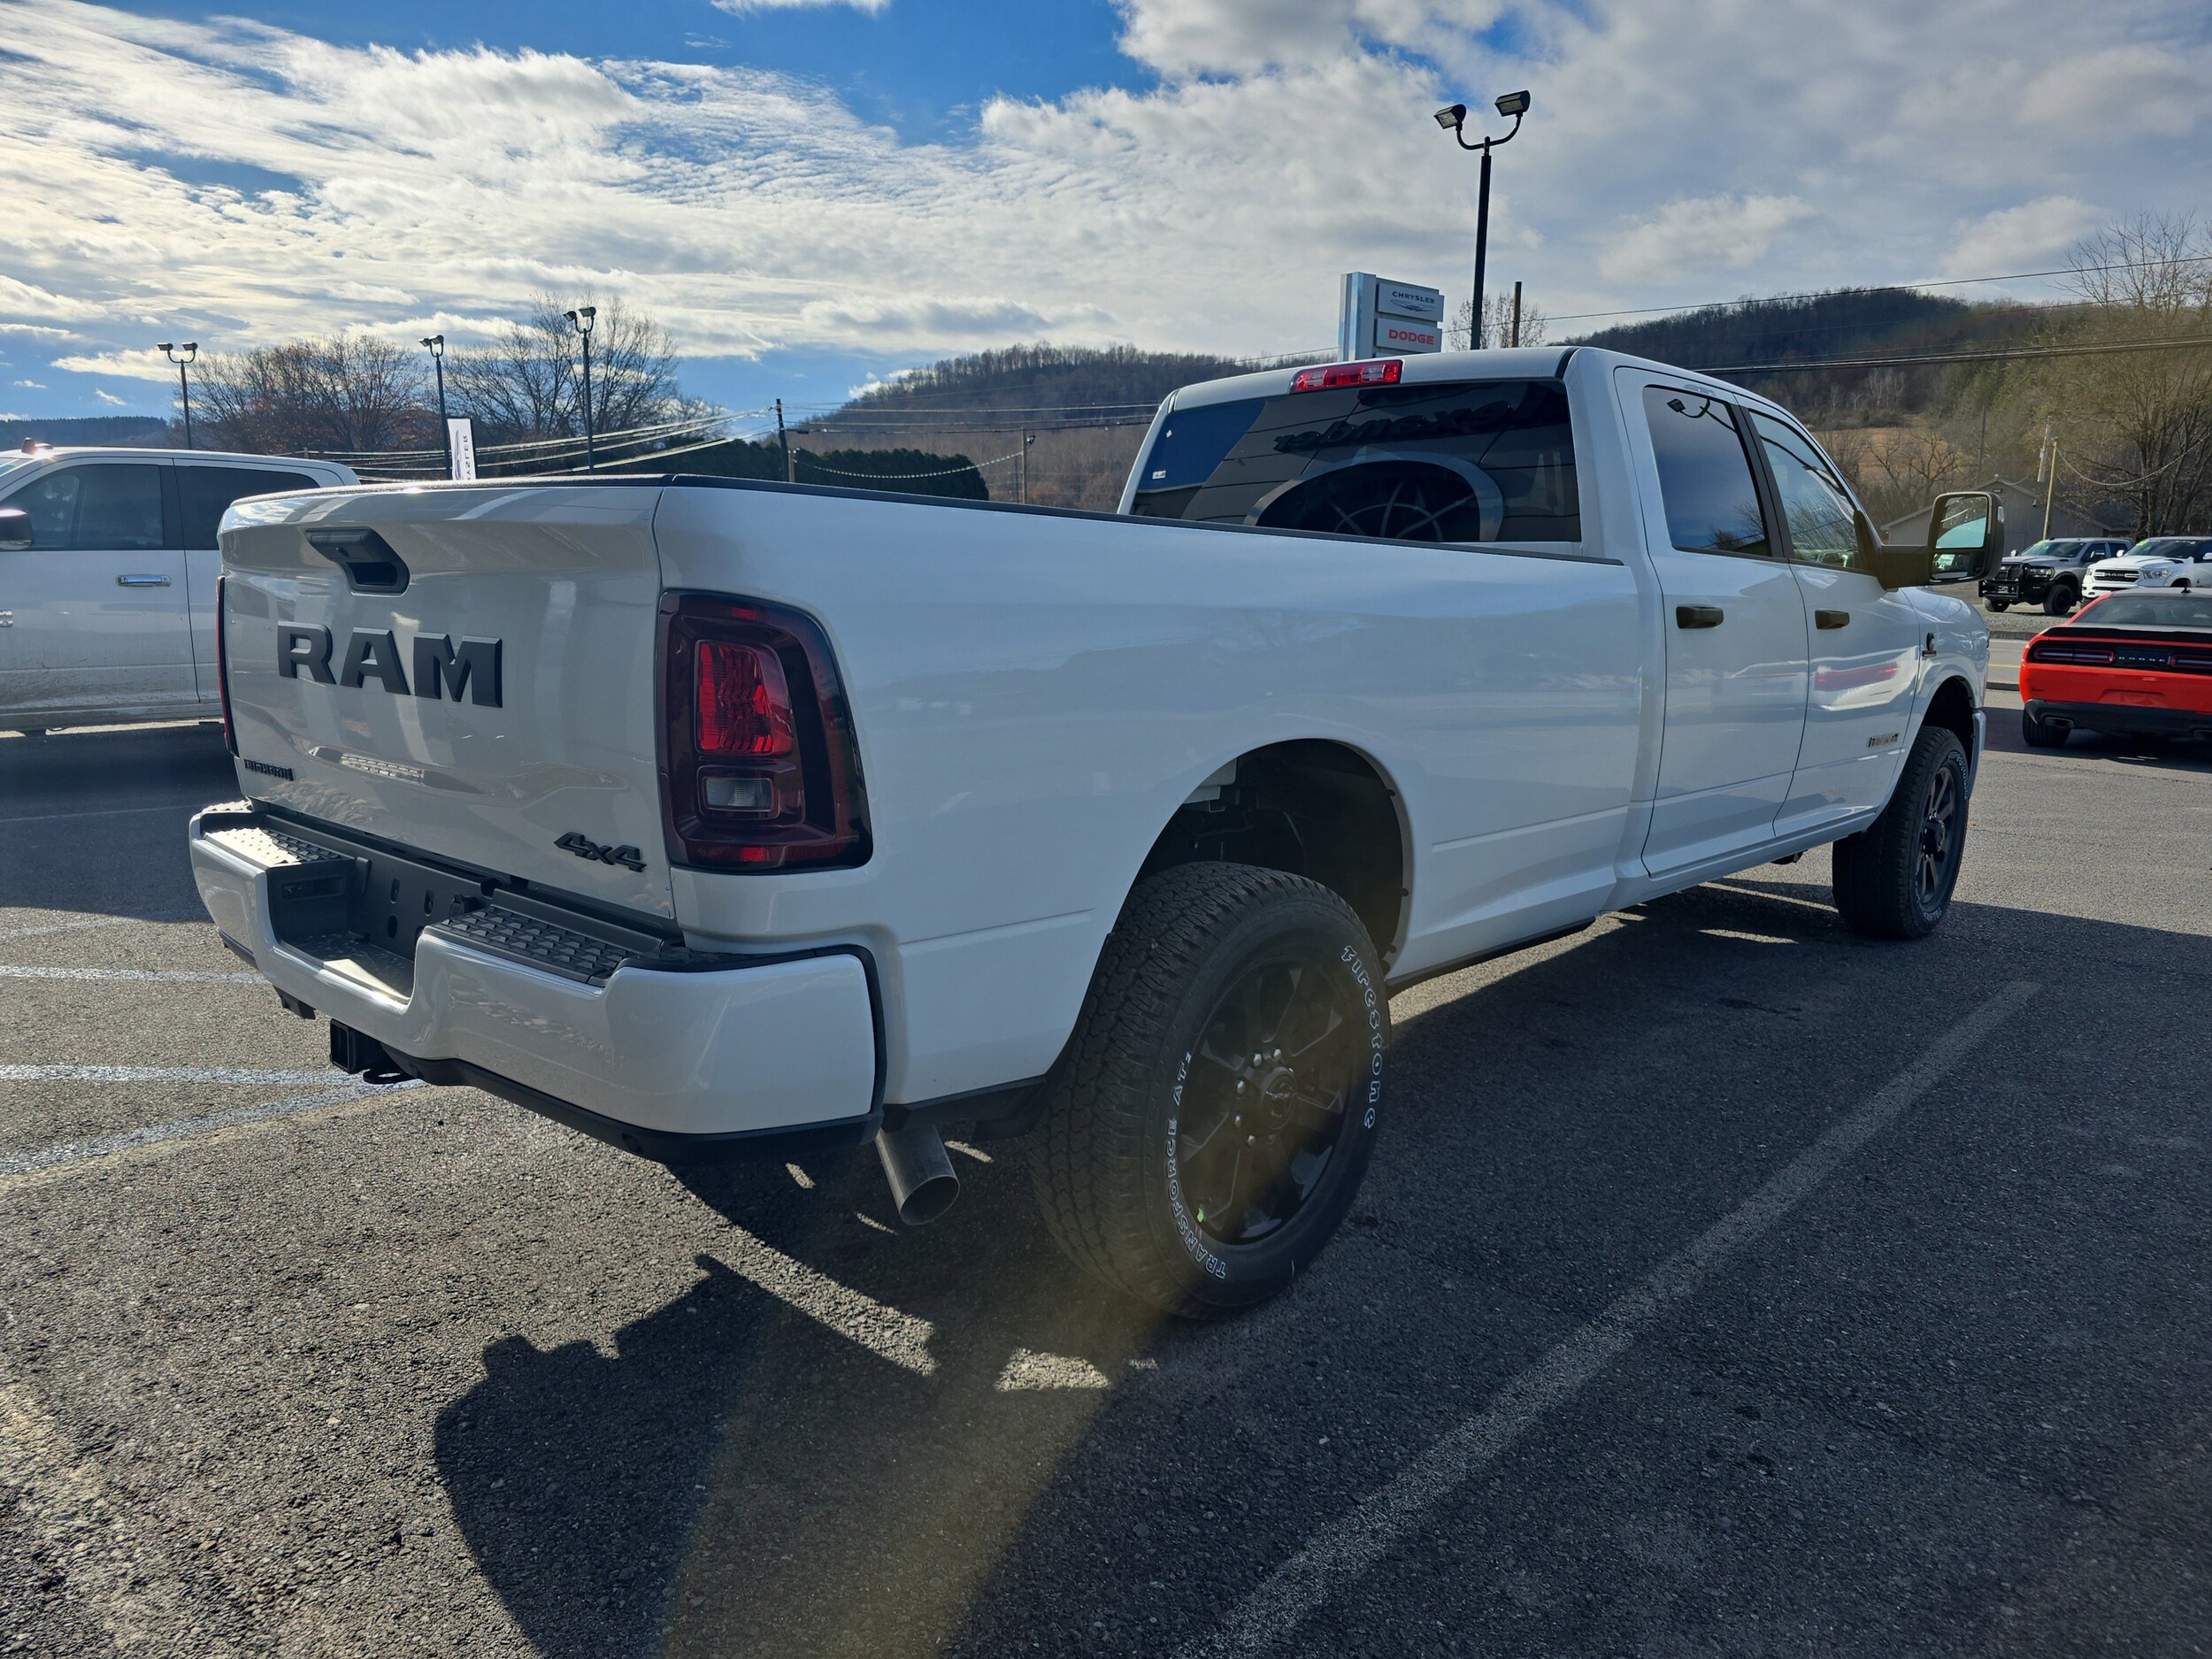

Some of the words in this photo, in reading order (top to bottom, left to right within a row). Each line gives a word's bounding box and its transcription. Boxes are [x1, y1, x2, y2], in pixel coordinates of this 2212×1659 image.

[1392, 291, 1435, 304] CHRYSLER
[1388, 329, 1434, 345] DODGE
[277, 620, 503, 709] RAM
[1166, 1118, 1226, 1279] TRANSFORCE
